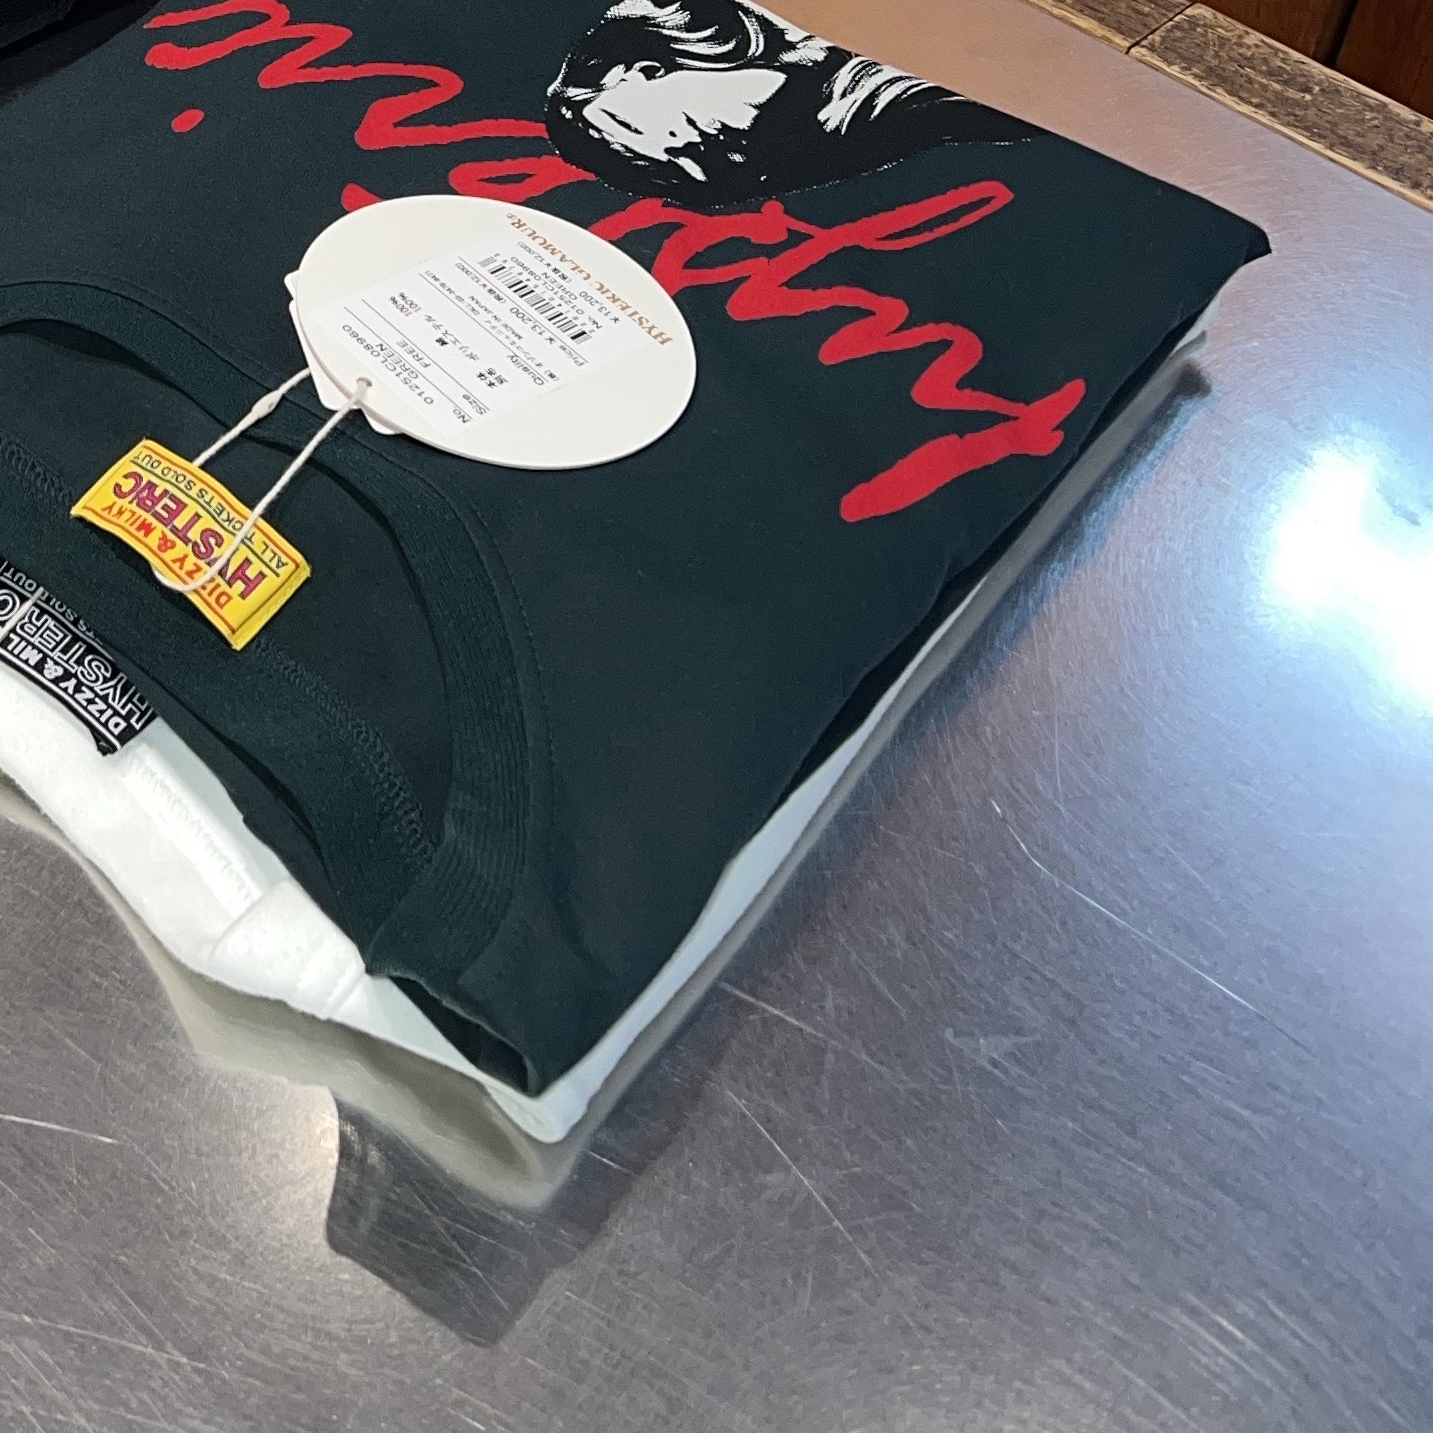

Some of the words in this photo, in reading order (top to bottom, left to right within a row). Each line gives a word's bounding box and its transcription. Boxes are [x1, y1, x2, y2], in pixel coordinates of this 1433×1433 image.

[540, 270, 578, 301] GREEN
[339, 323, 436, 405] 01251CL08960
[373, 341, 420, 380] GREEN
[394, 338, 433, 369] FREE
[555, 343, 586, 367] Price
[504, 352, 548, 386] Quality
[458, 392, 489, 416] Size
[133, 450, 161, 468] OUT
[160, 466, 195, 491] SOLD
[101, 501, 156, 538] MILKY
[195, 489, 256, 545] TCKETS
[157, 532, 177, 553] &
[260, 539, 289, 569] ALL
[3, 567, 41, 592] OUT
[43, 657, 64, 679] &
[59, 677, 128, 736] DIZZY
